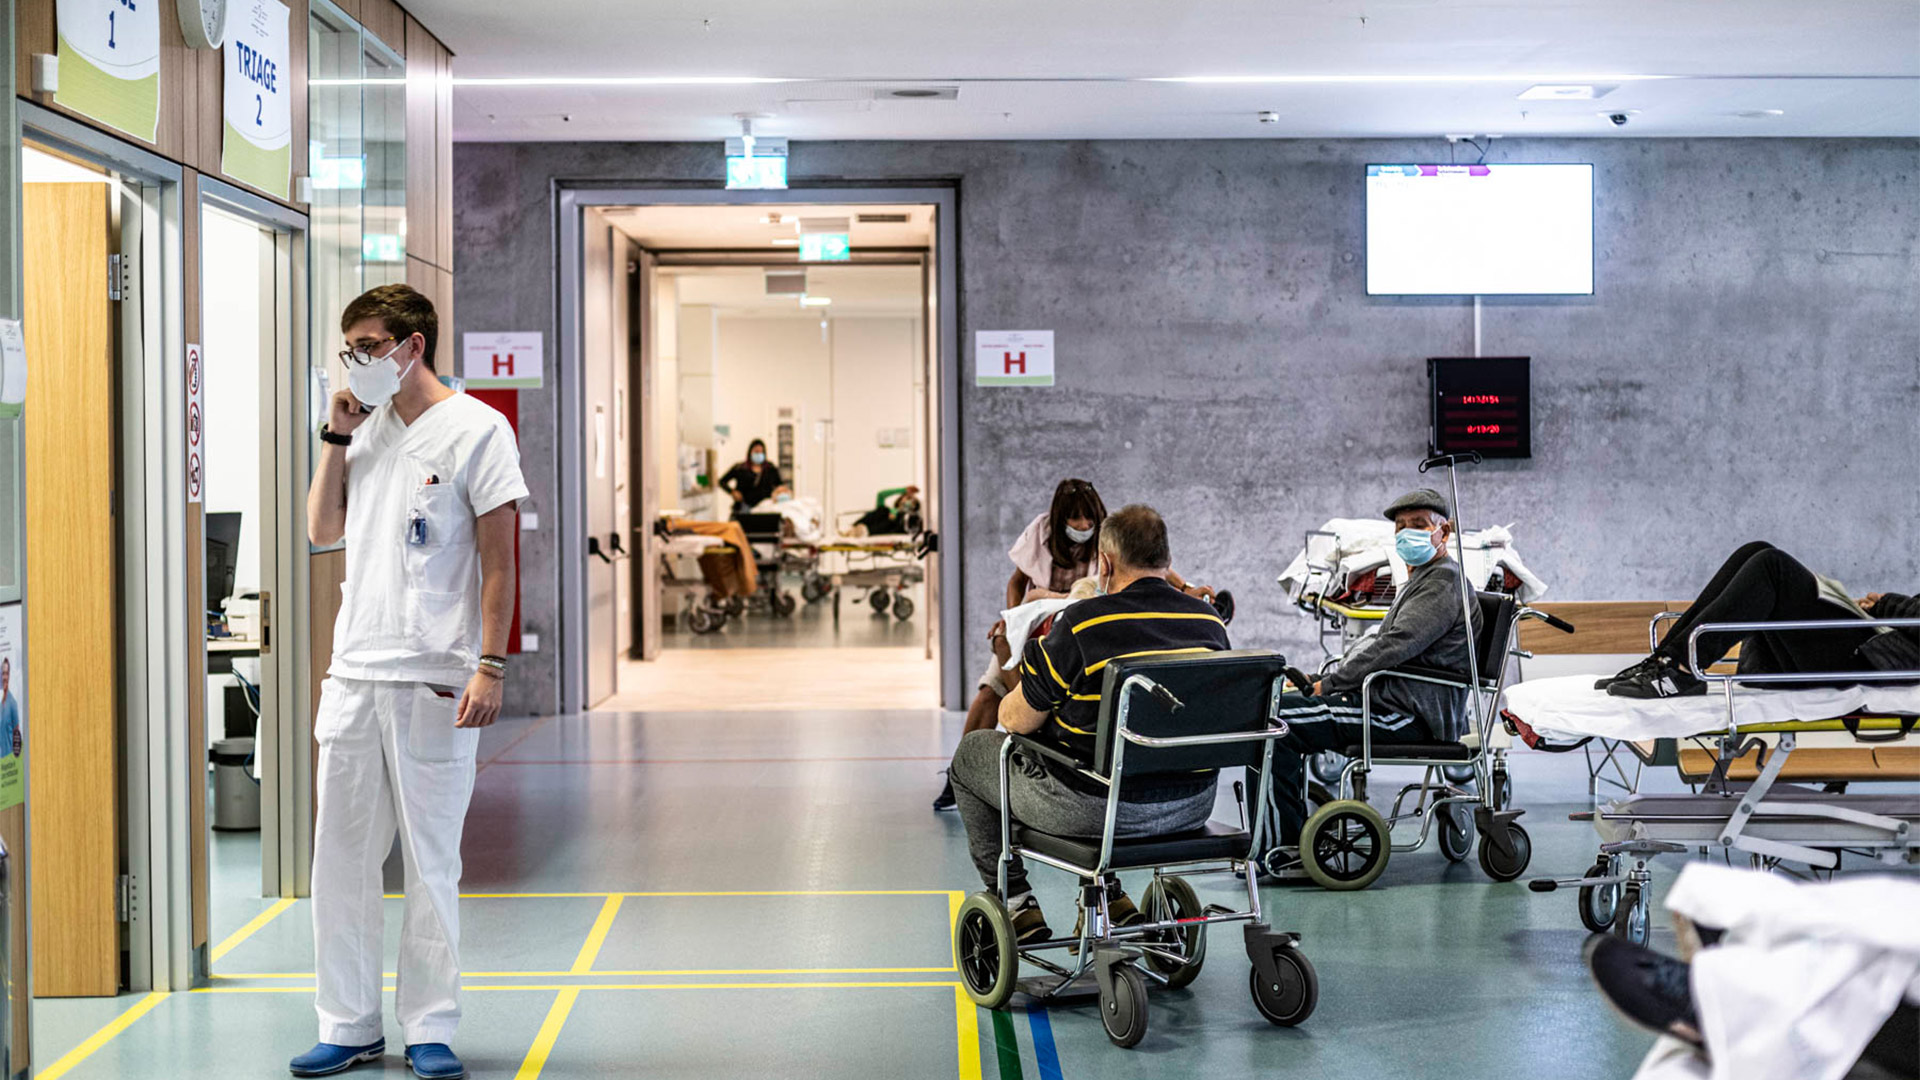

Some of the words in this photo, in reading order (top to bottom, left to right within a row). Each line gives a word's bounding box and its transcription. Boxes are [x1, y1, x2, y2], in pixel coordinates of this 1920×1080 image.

[108, 10, 116, 49] 1
[235, 40, 277, 94] TRIAGE
[256, 93, 263, 126] 2
[492, 353, 514, 377] H
[1004, 351, 1026, 375] H
